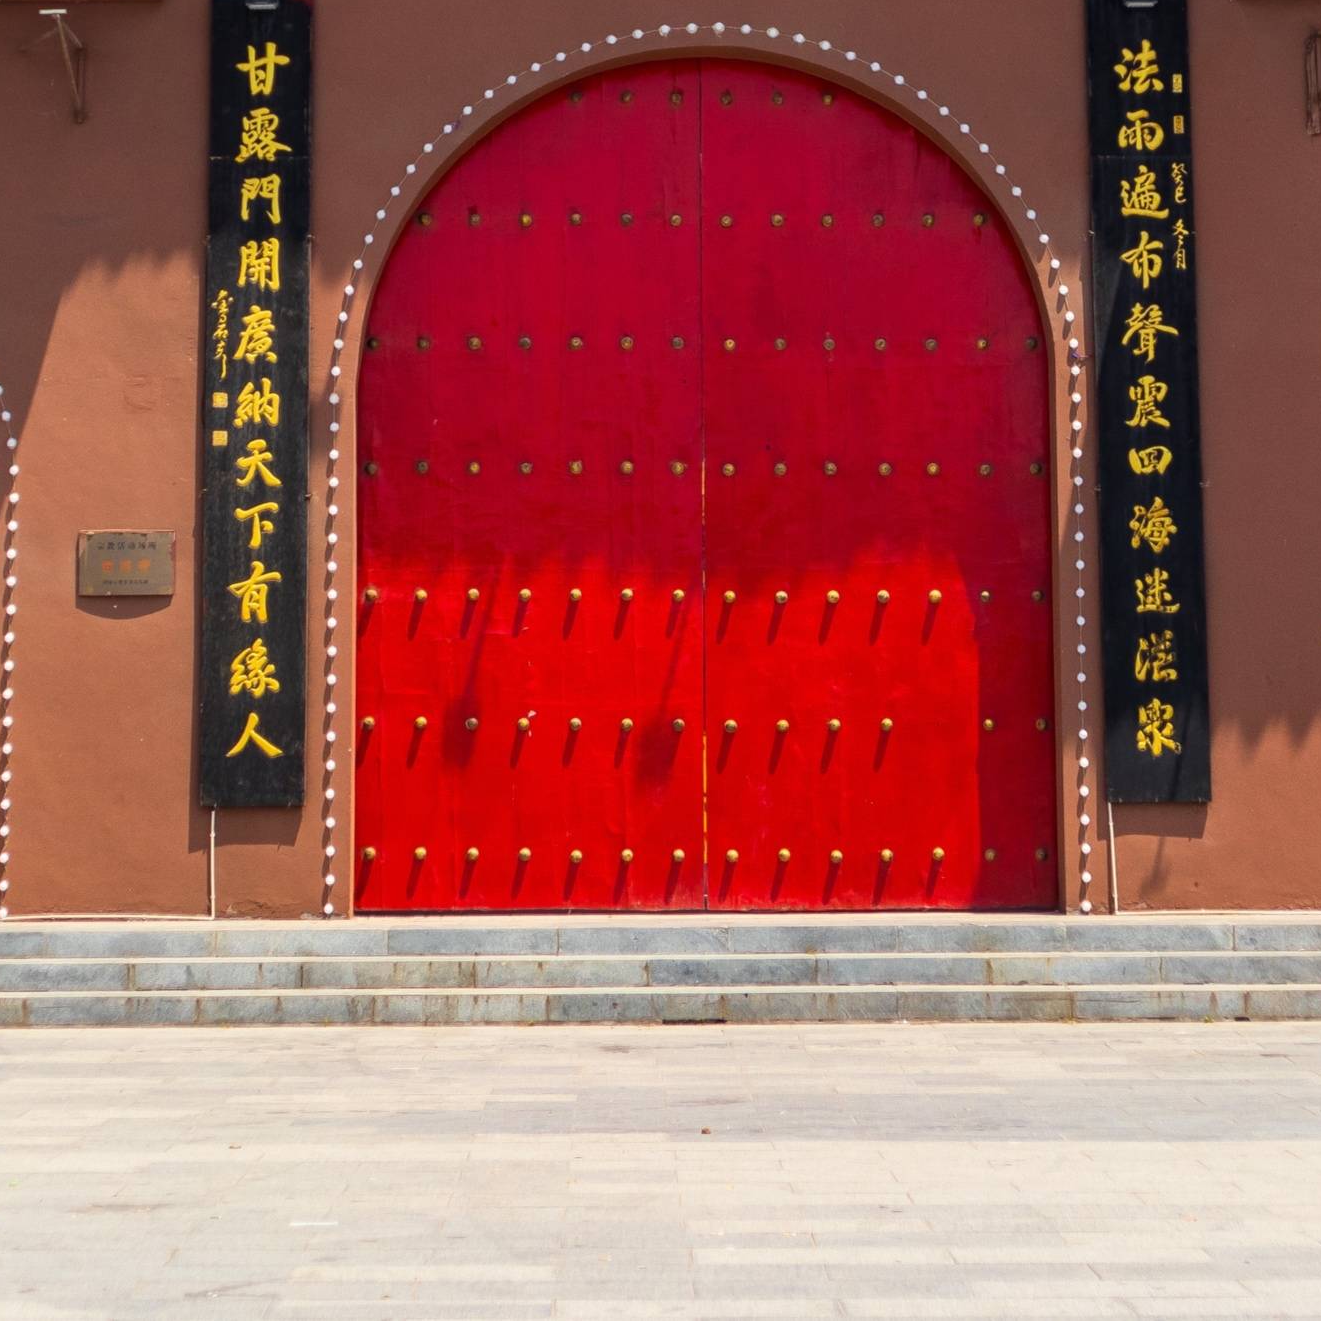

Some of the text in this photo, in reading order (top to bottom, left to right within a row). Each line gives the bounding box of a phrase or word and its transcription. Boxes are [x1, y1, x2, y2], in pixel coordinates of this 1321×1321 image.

[223, 42, 292, 758] 甘露門開廣納天下有緣人
